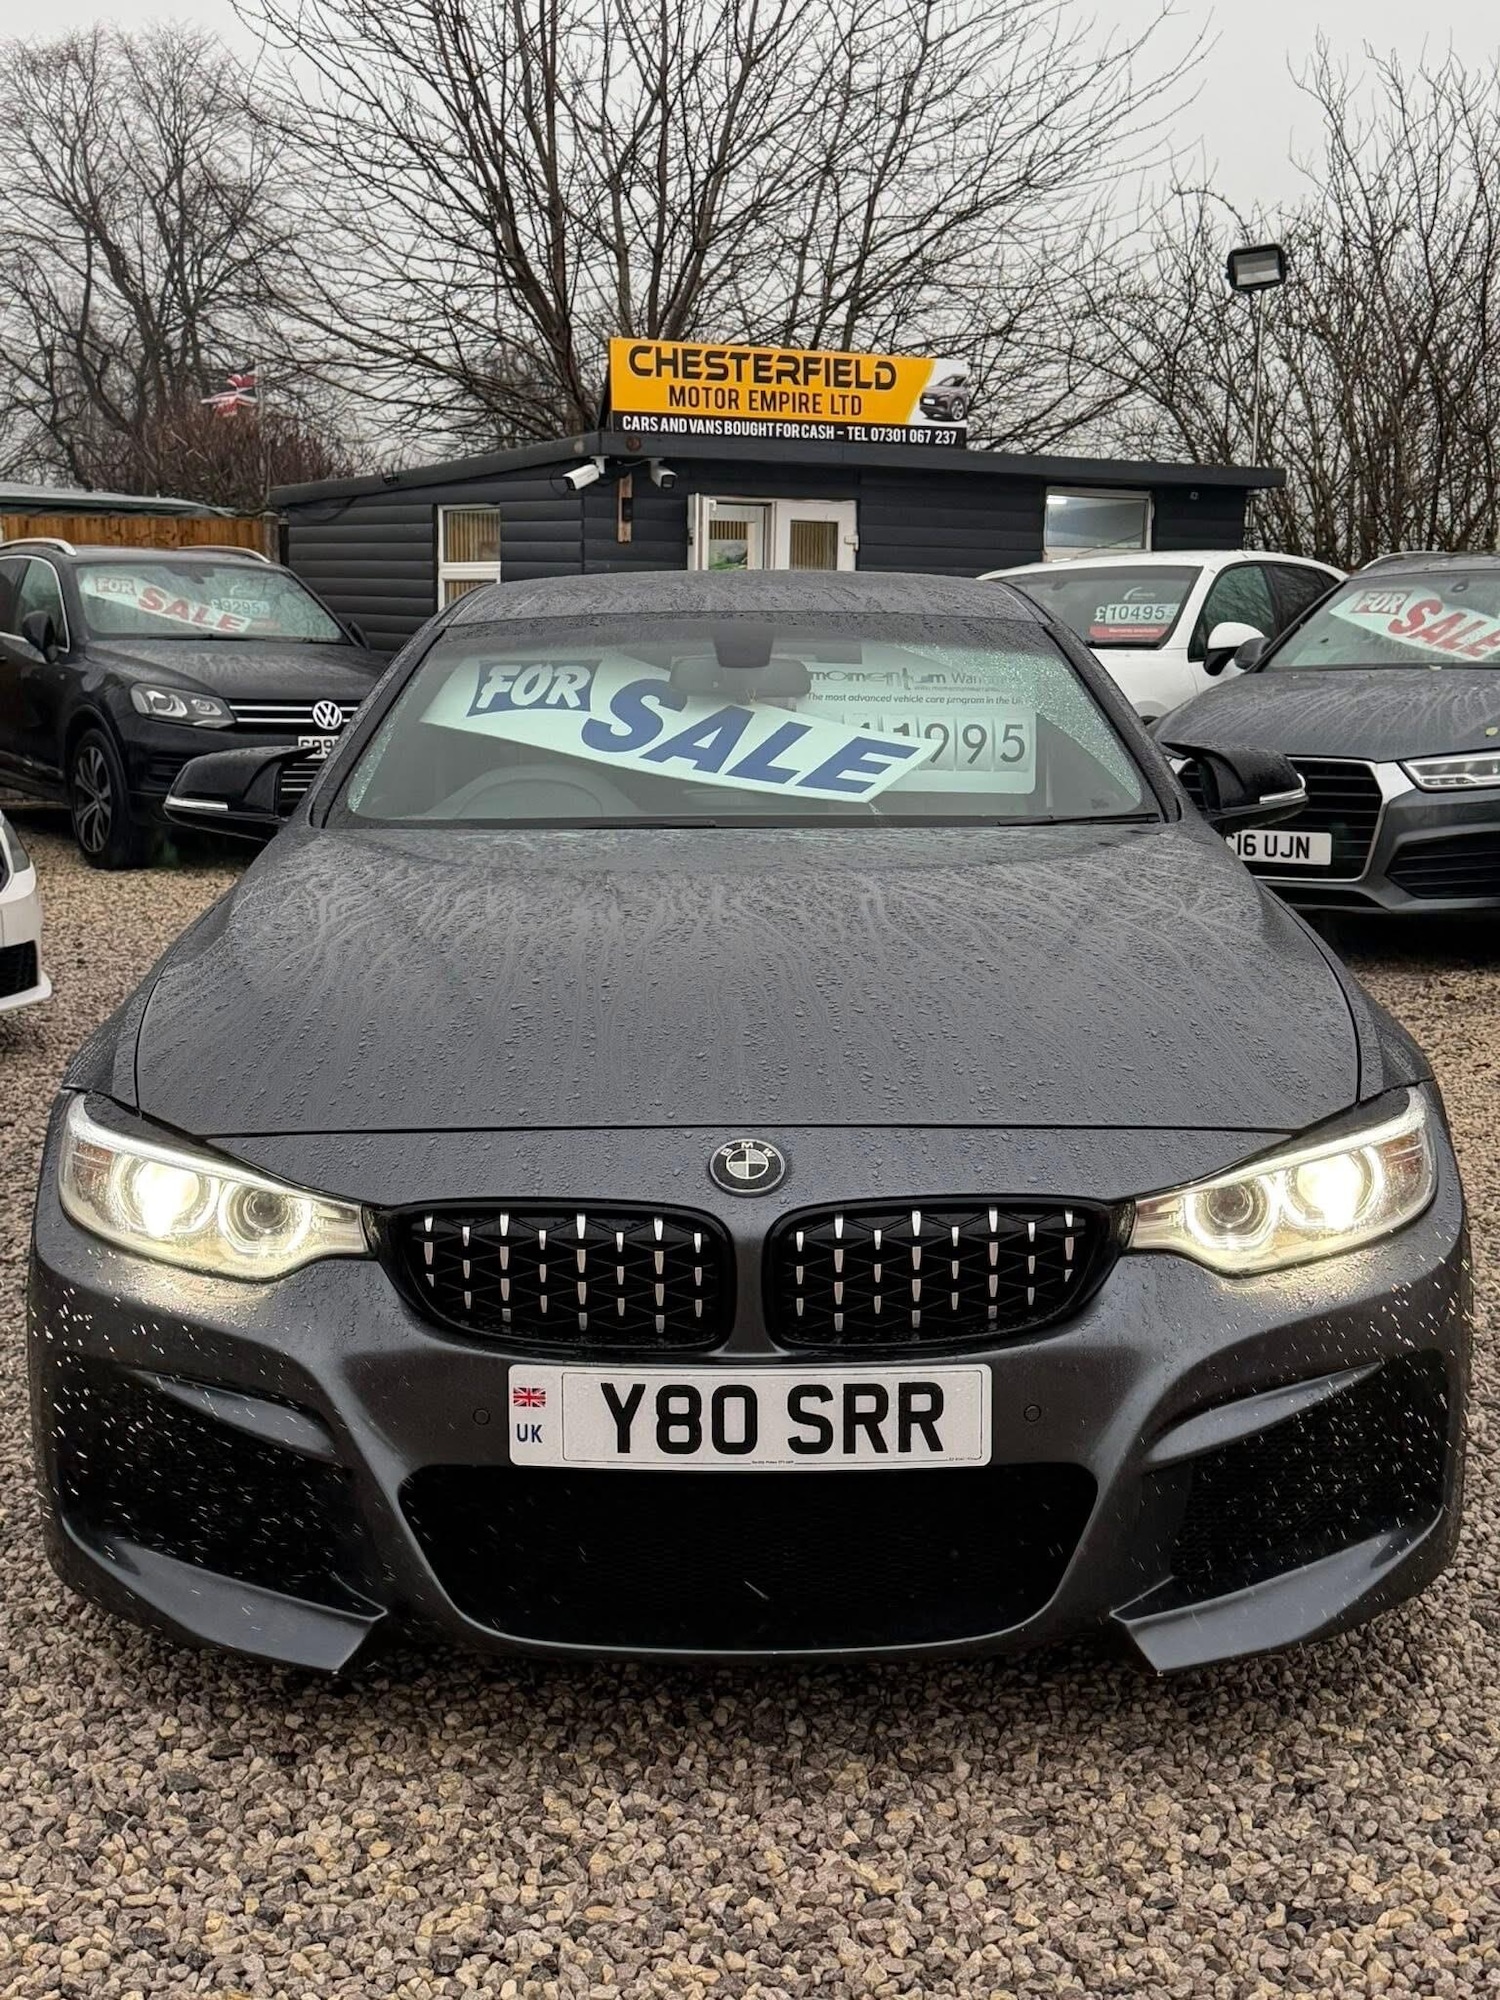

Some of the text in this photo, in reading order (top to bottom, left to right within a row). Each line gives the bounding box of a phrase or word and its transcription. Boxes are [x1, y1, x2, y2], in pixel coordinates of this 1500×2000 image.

[628, 345, 897, 390] CHESTERFIELD
[668, 385, 862, 416] MOTOR EMPIRE LTD
[622, 415, 658, 432] CARS
[660, 416, 688, 433] AND
[689, 417, 724, 435] VANS
[724, 420, 775, 437] BOUGHT
[775, 423, 800, 438] FOR
[801, 423, 834, 440] CASH
[847, 425, 868, 441] TEL
[870, 427, 906, 443] 07301
[909, 428, 931, 444] 067
[934, 429, 957, 445] 237
[97, 577, 246, 632] FOR SALE
[1354, 591, 1407, 614] FOR
[825, 693, 846, 701] most
[847, 694, 892, 702] advanced
[893, 694, 923, 703] vehicle
[475, 662, 921, 794] FOR SALE
[1265, 835, 1310, 859] UJN
[720, 1142, 776, 1157] BMW
[600, 1381, 945, 1455] Y80 SRR
[516, 1424, 543, 1444] UK
